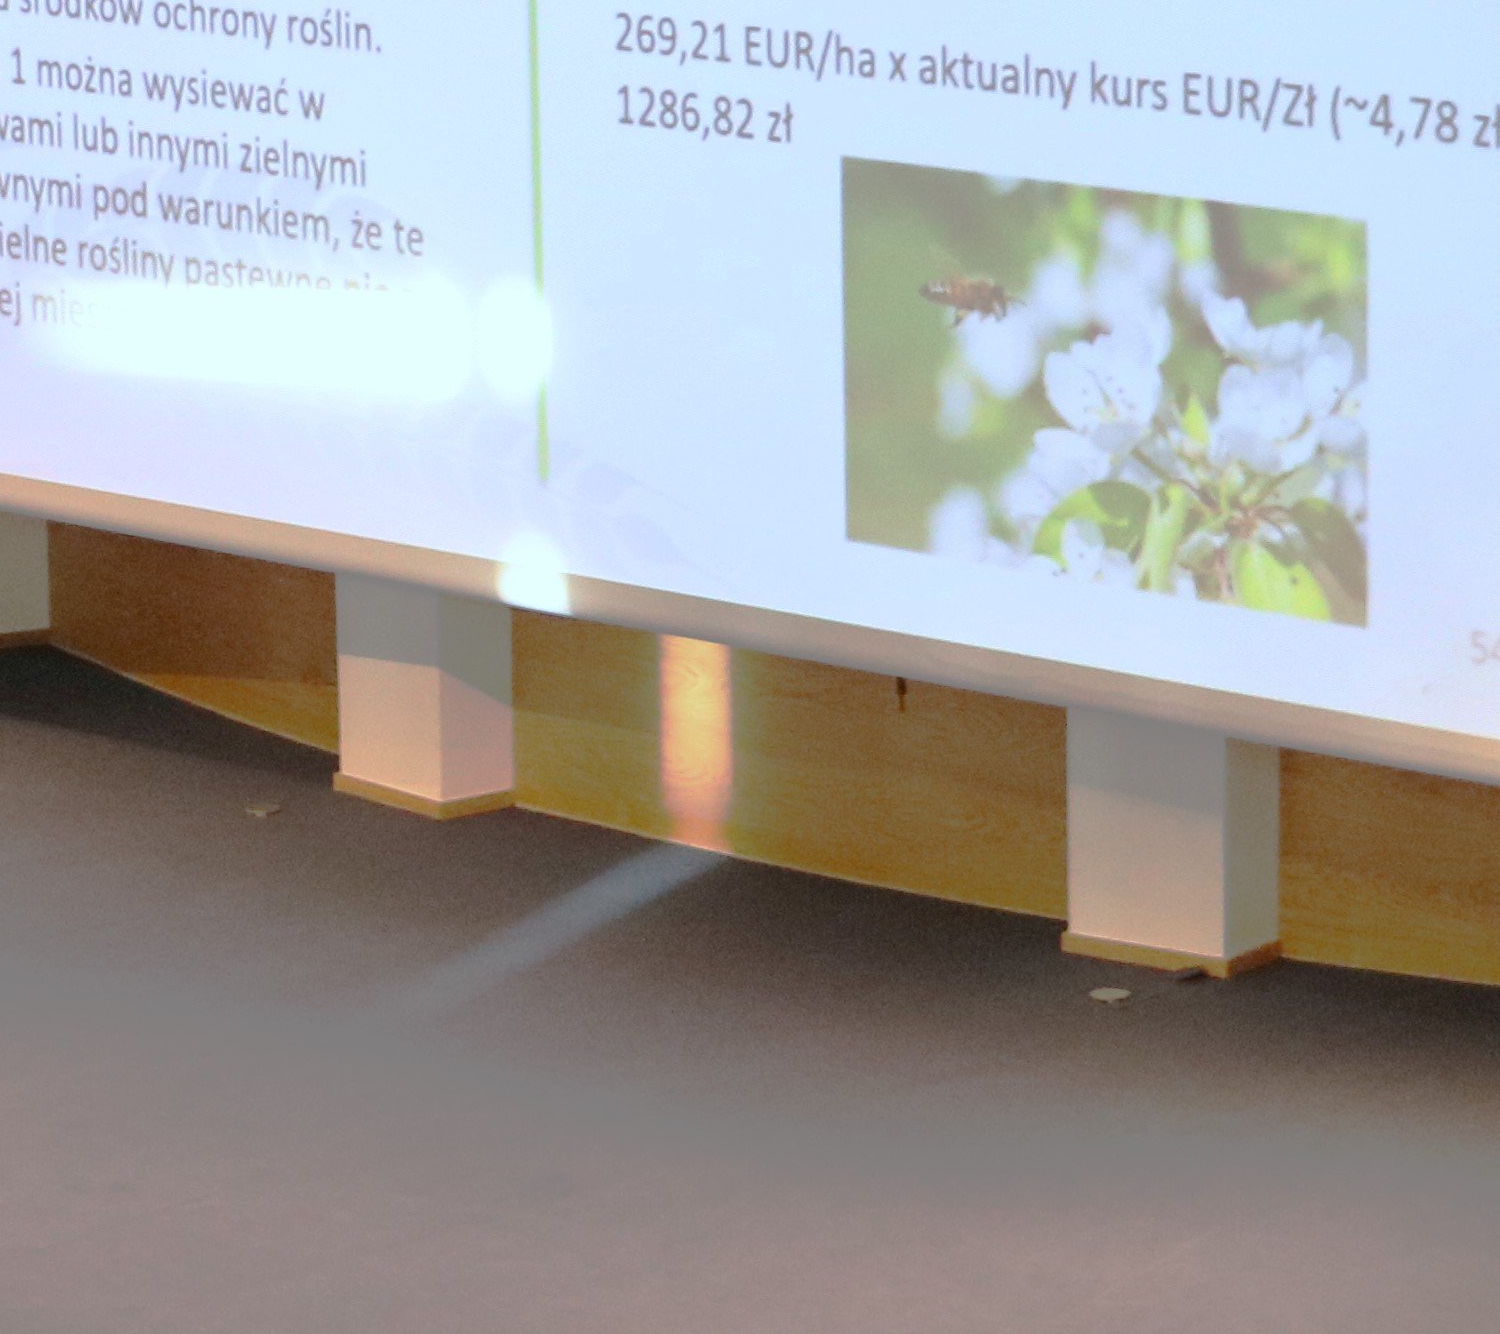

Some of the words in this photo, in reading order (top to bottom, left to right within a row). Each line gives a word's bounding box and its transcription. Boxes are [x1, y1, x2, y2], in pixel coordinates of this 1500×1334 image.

[287, 8, 381, 53] roślin.
[37, 56, 132, 97] można
[142, 69, 288, 116] wysiewać
[616, 11, 731, 65] 269,21
[745, 25, 876, 81] EUR/ha
[919, 44, 1077, 110] aktualny
[1090, 60, 1168, 111] kurs
[1330, 85, 1459, 146] (~4,78
[618, 84, 754, 140] 1286,82
[767, 102, 793, 143] zł
[73, 112, 118, 155] lub
[128, 119, 228, 173] innymi
[240, 136, 366, 191] zielnymi
[92, 181, 147, 221] pod
[157, 192, 339, 252] warunkiem,
[351, 209, 382, 251] że
[393, 218, 424, 256] te
[77, 236, 174, 283] rośliny
